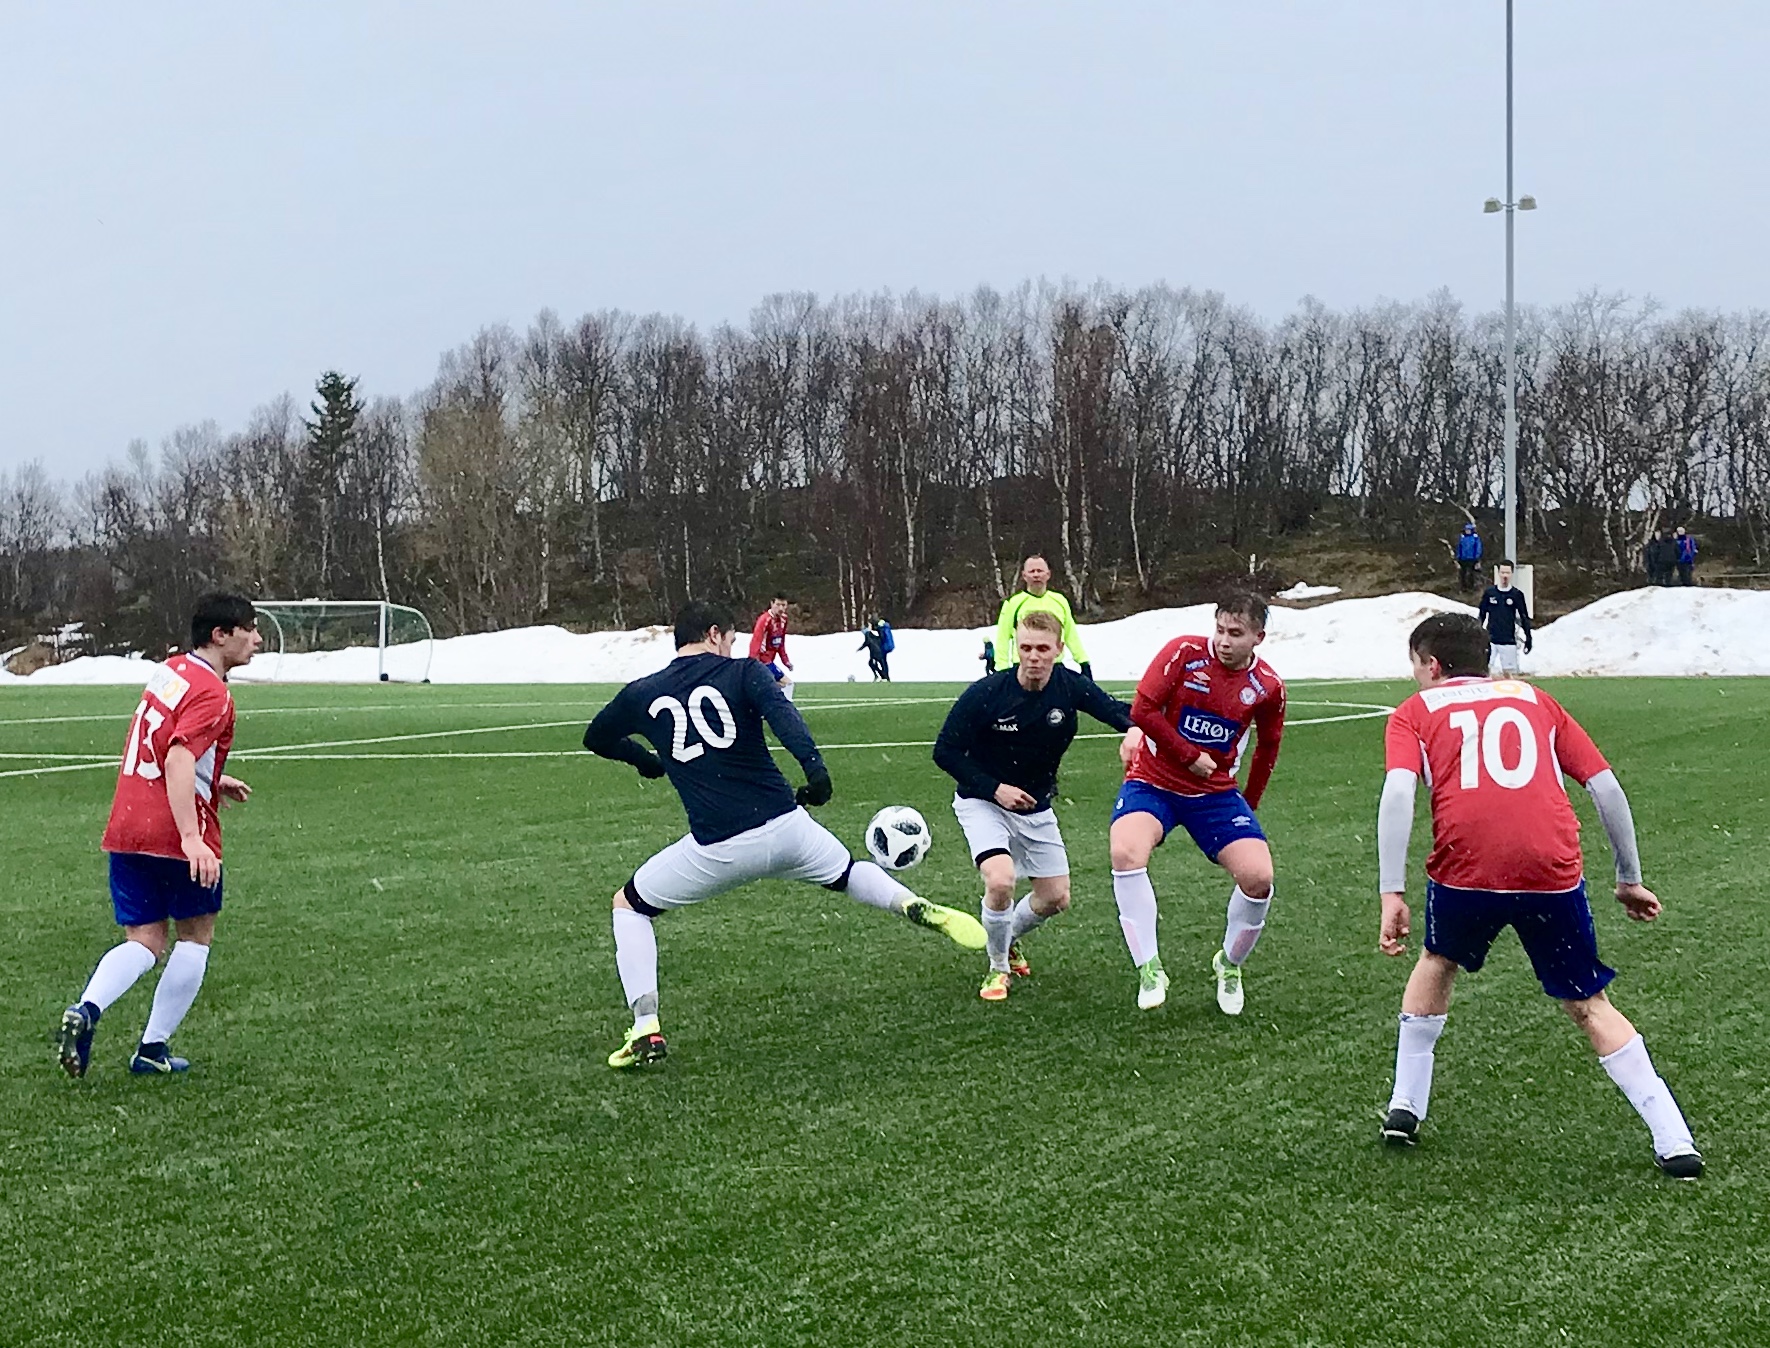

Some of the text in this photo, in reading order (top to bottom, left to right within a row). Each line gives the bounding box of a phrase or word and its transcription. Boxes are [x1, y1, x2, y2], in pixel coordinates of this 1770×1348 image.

[123, 700, 165, 779] 13
[648, 685, 737, 763] 20
[1449, 706, 1538, 790] 10
